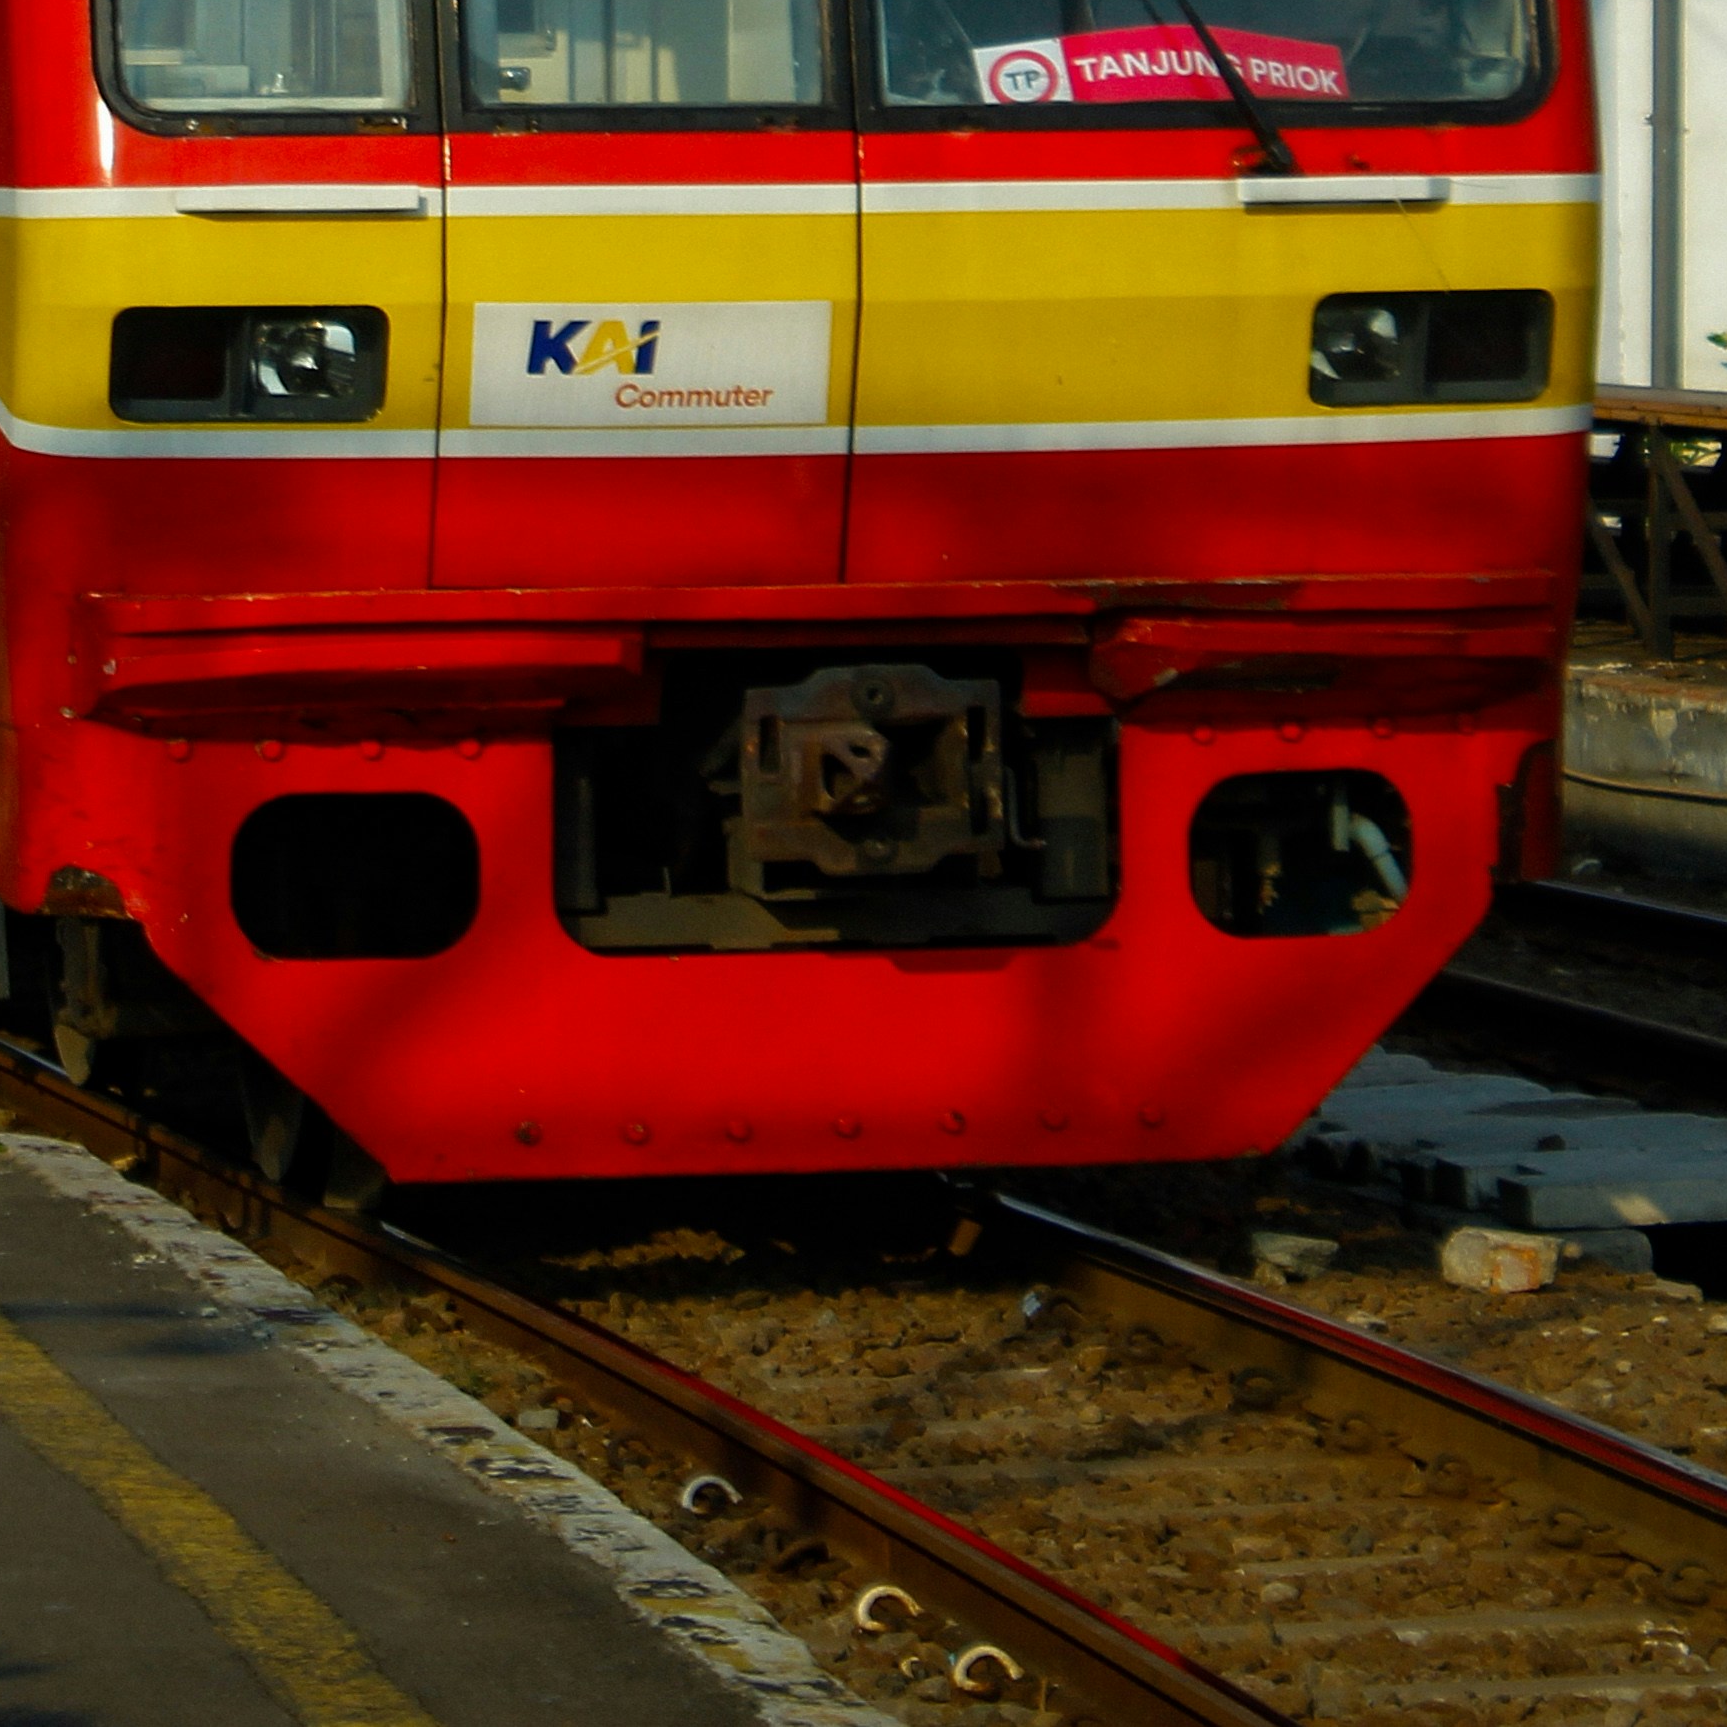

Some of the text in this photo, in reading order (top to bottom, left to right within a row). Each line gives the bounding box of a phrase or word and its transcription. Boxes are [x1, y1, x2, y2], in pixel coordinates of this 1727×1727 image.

[1003, 69, 1041, 92] TP
[1249, 56, 1345, 97] PRIOK
[526, 319, 662, 375] KAI
[614, 382, 774, 409] Commuter
